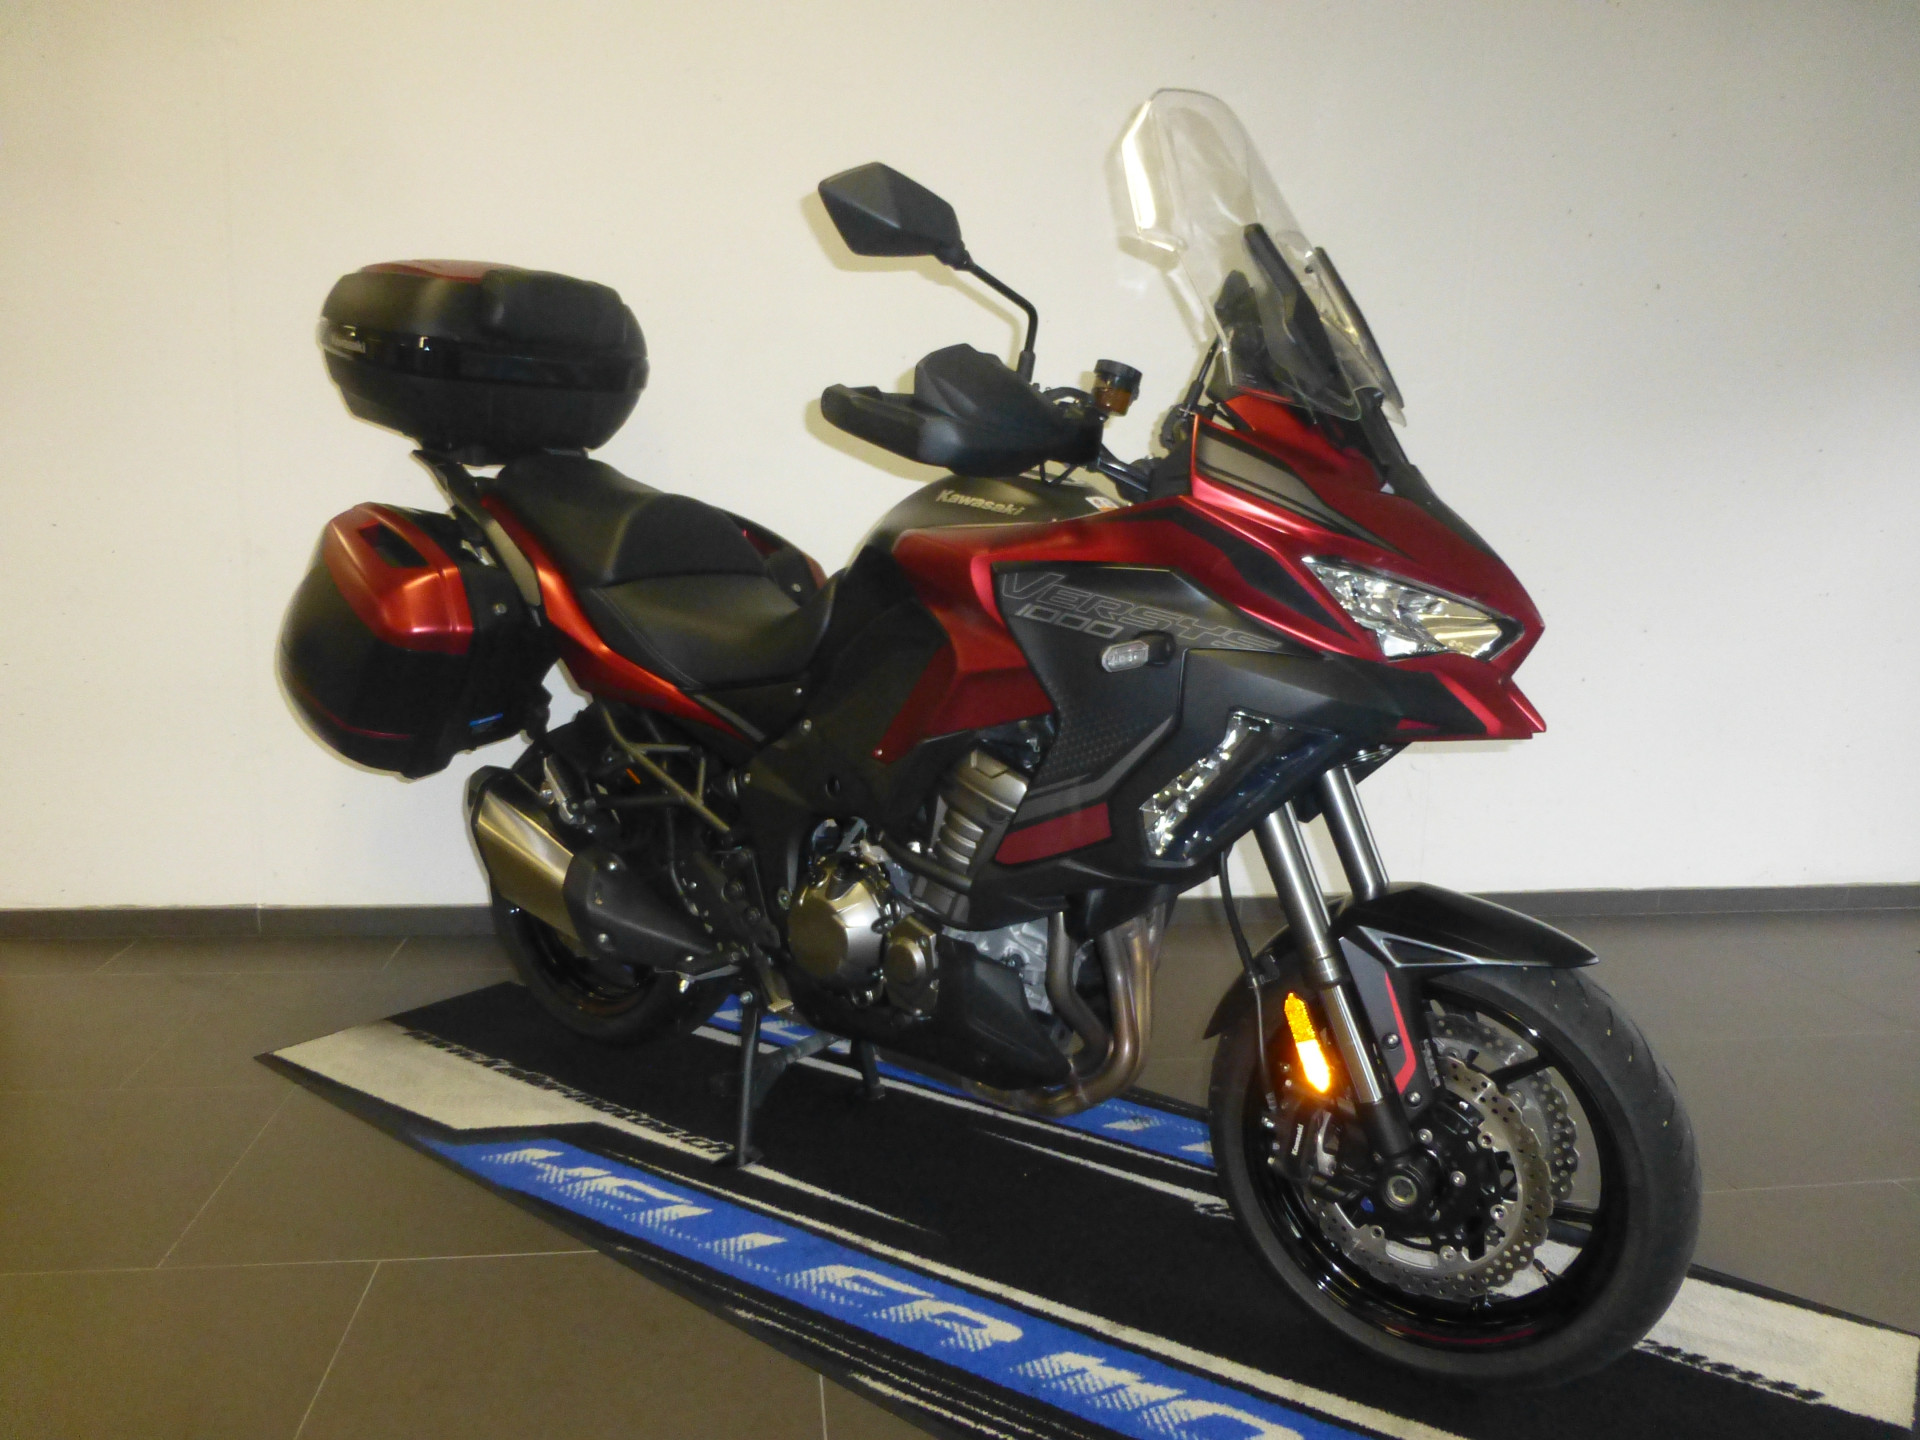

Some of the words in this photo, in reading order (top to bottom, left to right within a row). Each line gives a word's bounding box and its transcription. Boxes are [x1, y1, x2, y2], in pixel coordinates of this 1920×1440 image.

[936, 489, 1026, 516] Kawasaki
[1001, 572, 1282, 650] VERSYS
[1015, 603, 1123, 639] 1000
